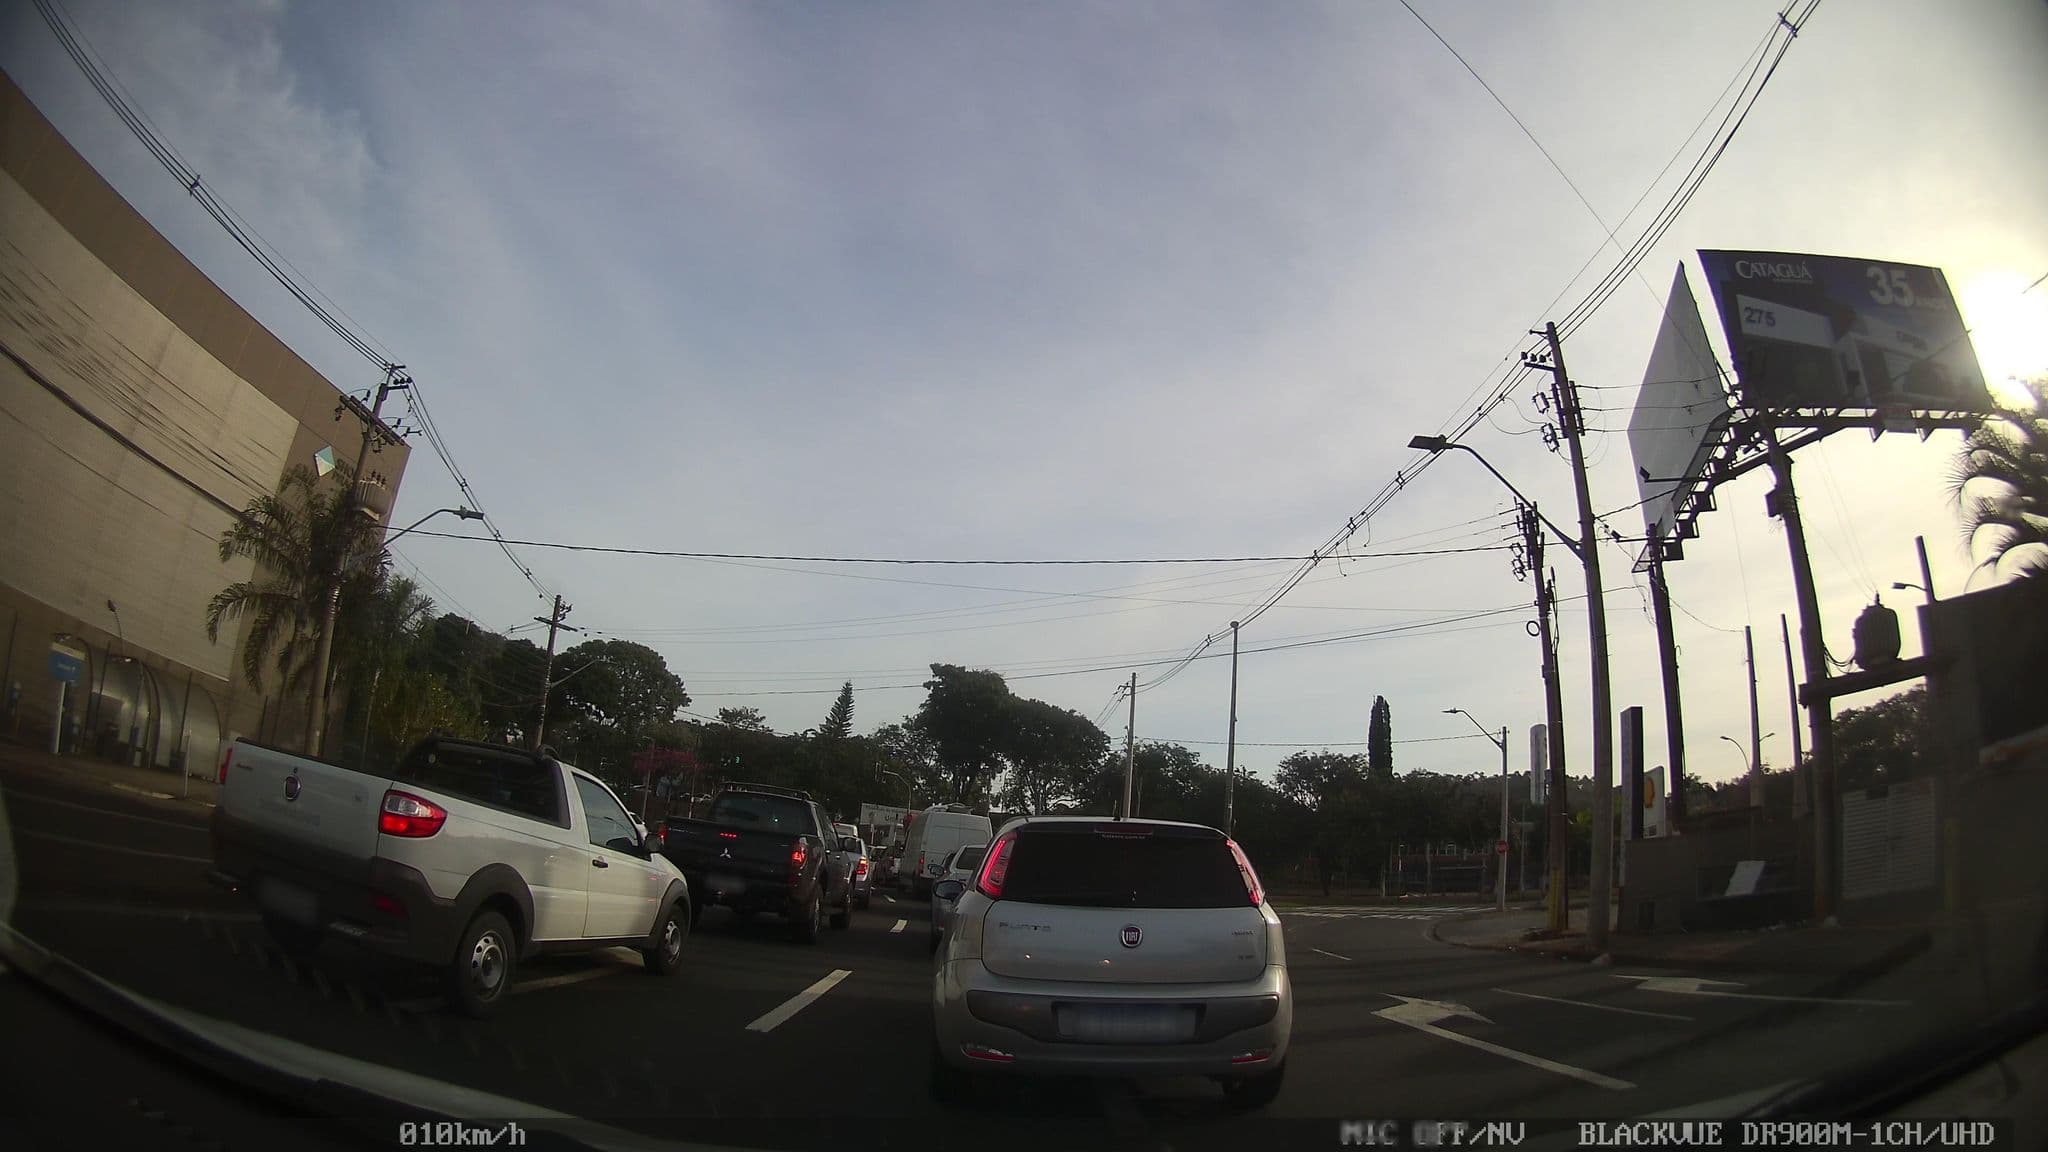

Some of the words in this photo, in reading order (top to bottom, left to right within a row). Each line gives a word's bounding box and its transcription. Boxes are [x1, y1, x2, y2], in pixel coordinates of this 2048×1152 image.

[1735, 259, 1813, 280] CATAGUÁ
[1866, 266, 1914, 307] 35
[1744, 306, 1776, 328] 275
